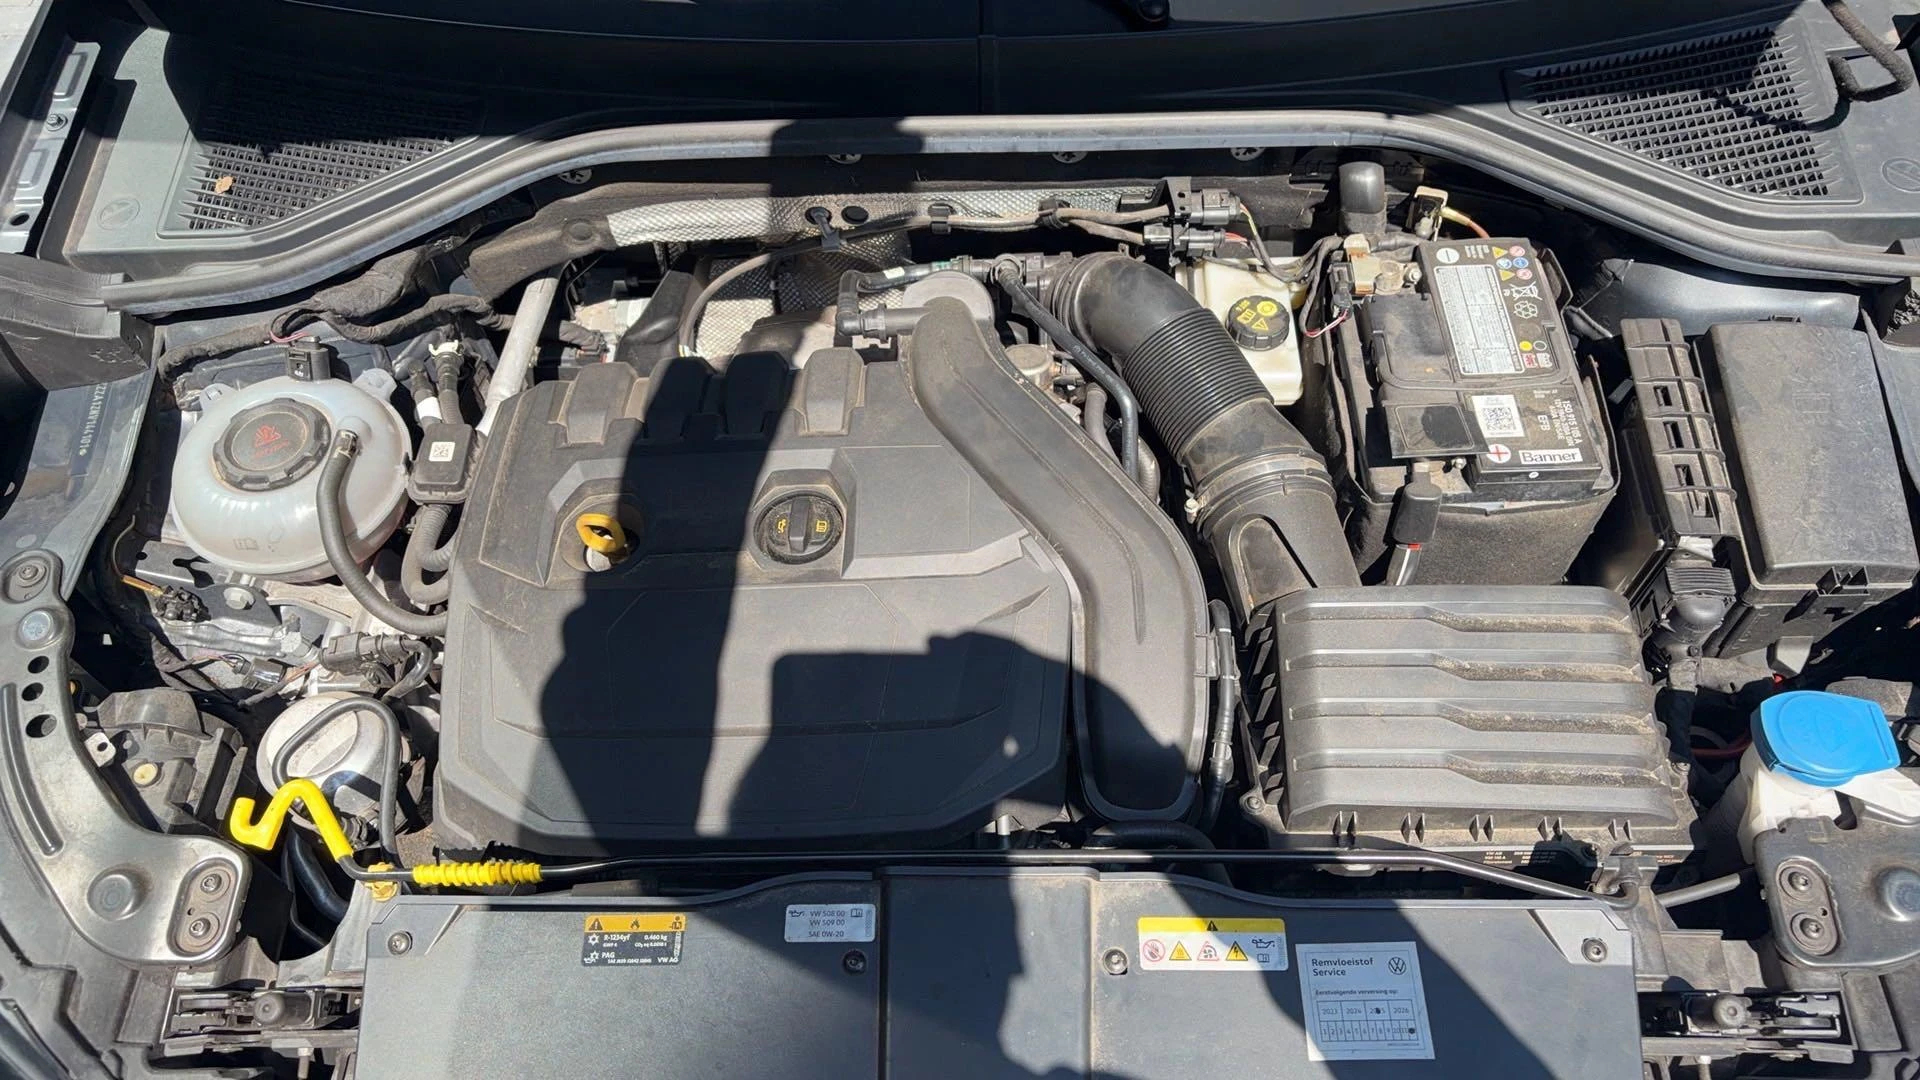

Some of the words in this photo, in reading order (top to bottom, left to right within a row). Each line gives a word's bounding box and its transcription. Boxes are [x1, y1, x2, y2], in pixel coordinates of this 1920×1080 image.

[1537, 414, 1551, 431] EFB
[1521, 452, 1578, 462] Banner
[1311, 957, 1373, 967] Remvloeistof
[1313, 968, 1346, 976] Service
[1369, 1007, 1386, 1015] 25
